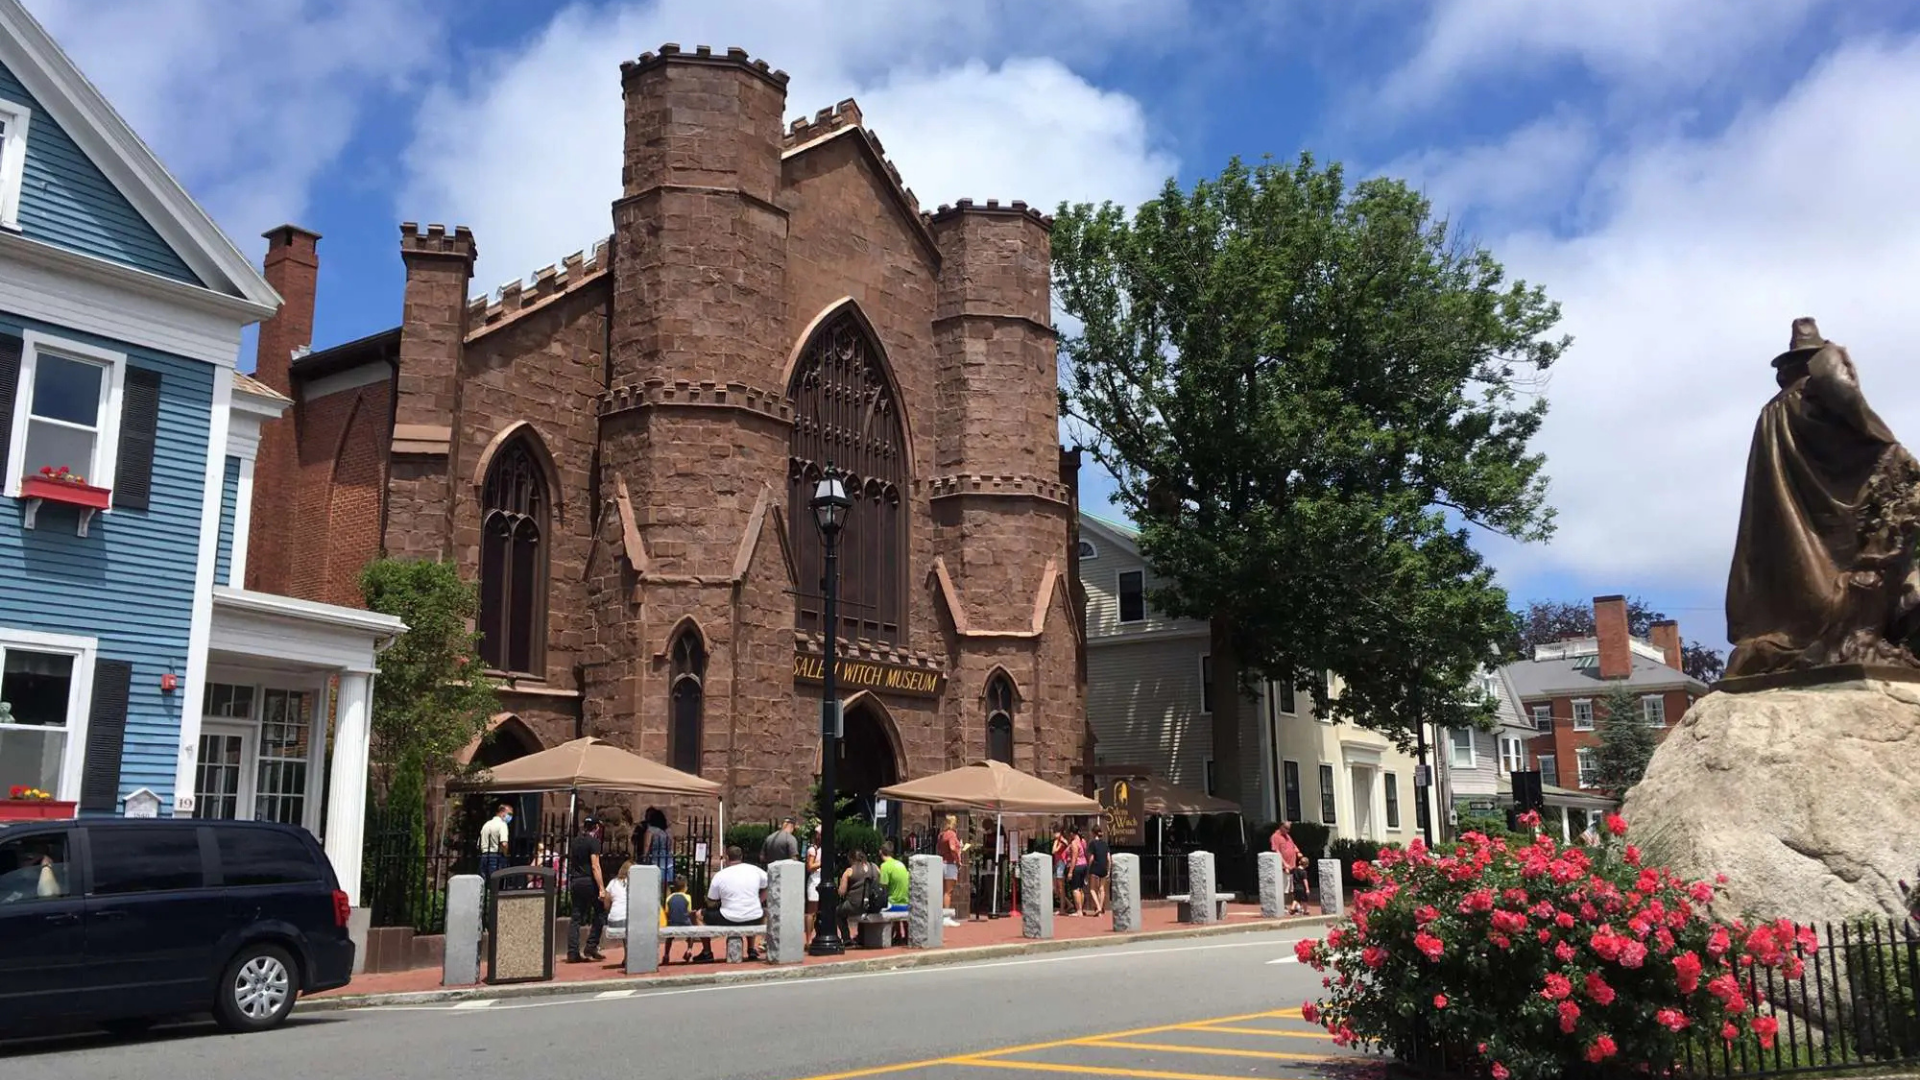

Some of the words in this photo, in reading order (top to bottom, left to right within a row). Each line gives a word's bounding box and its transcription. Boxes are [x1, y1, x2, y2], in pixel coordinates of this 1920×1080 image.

[843, 663, 883, 686] WITCH
[885, 669, 938, 693] MUSEUM
[179, 798, 193, 809] 19
[1106, 805, 1129, 824] Salem
[1114, 815, 1138, 828] Witch
[1106, 823, 1137, 836] Museum
